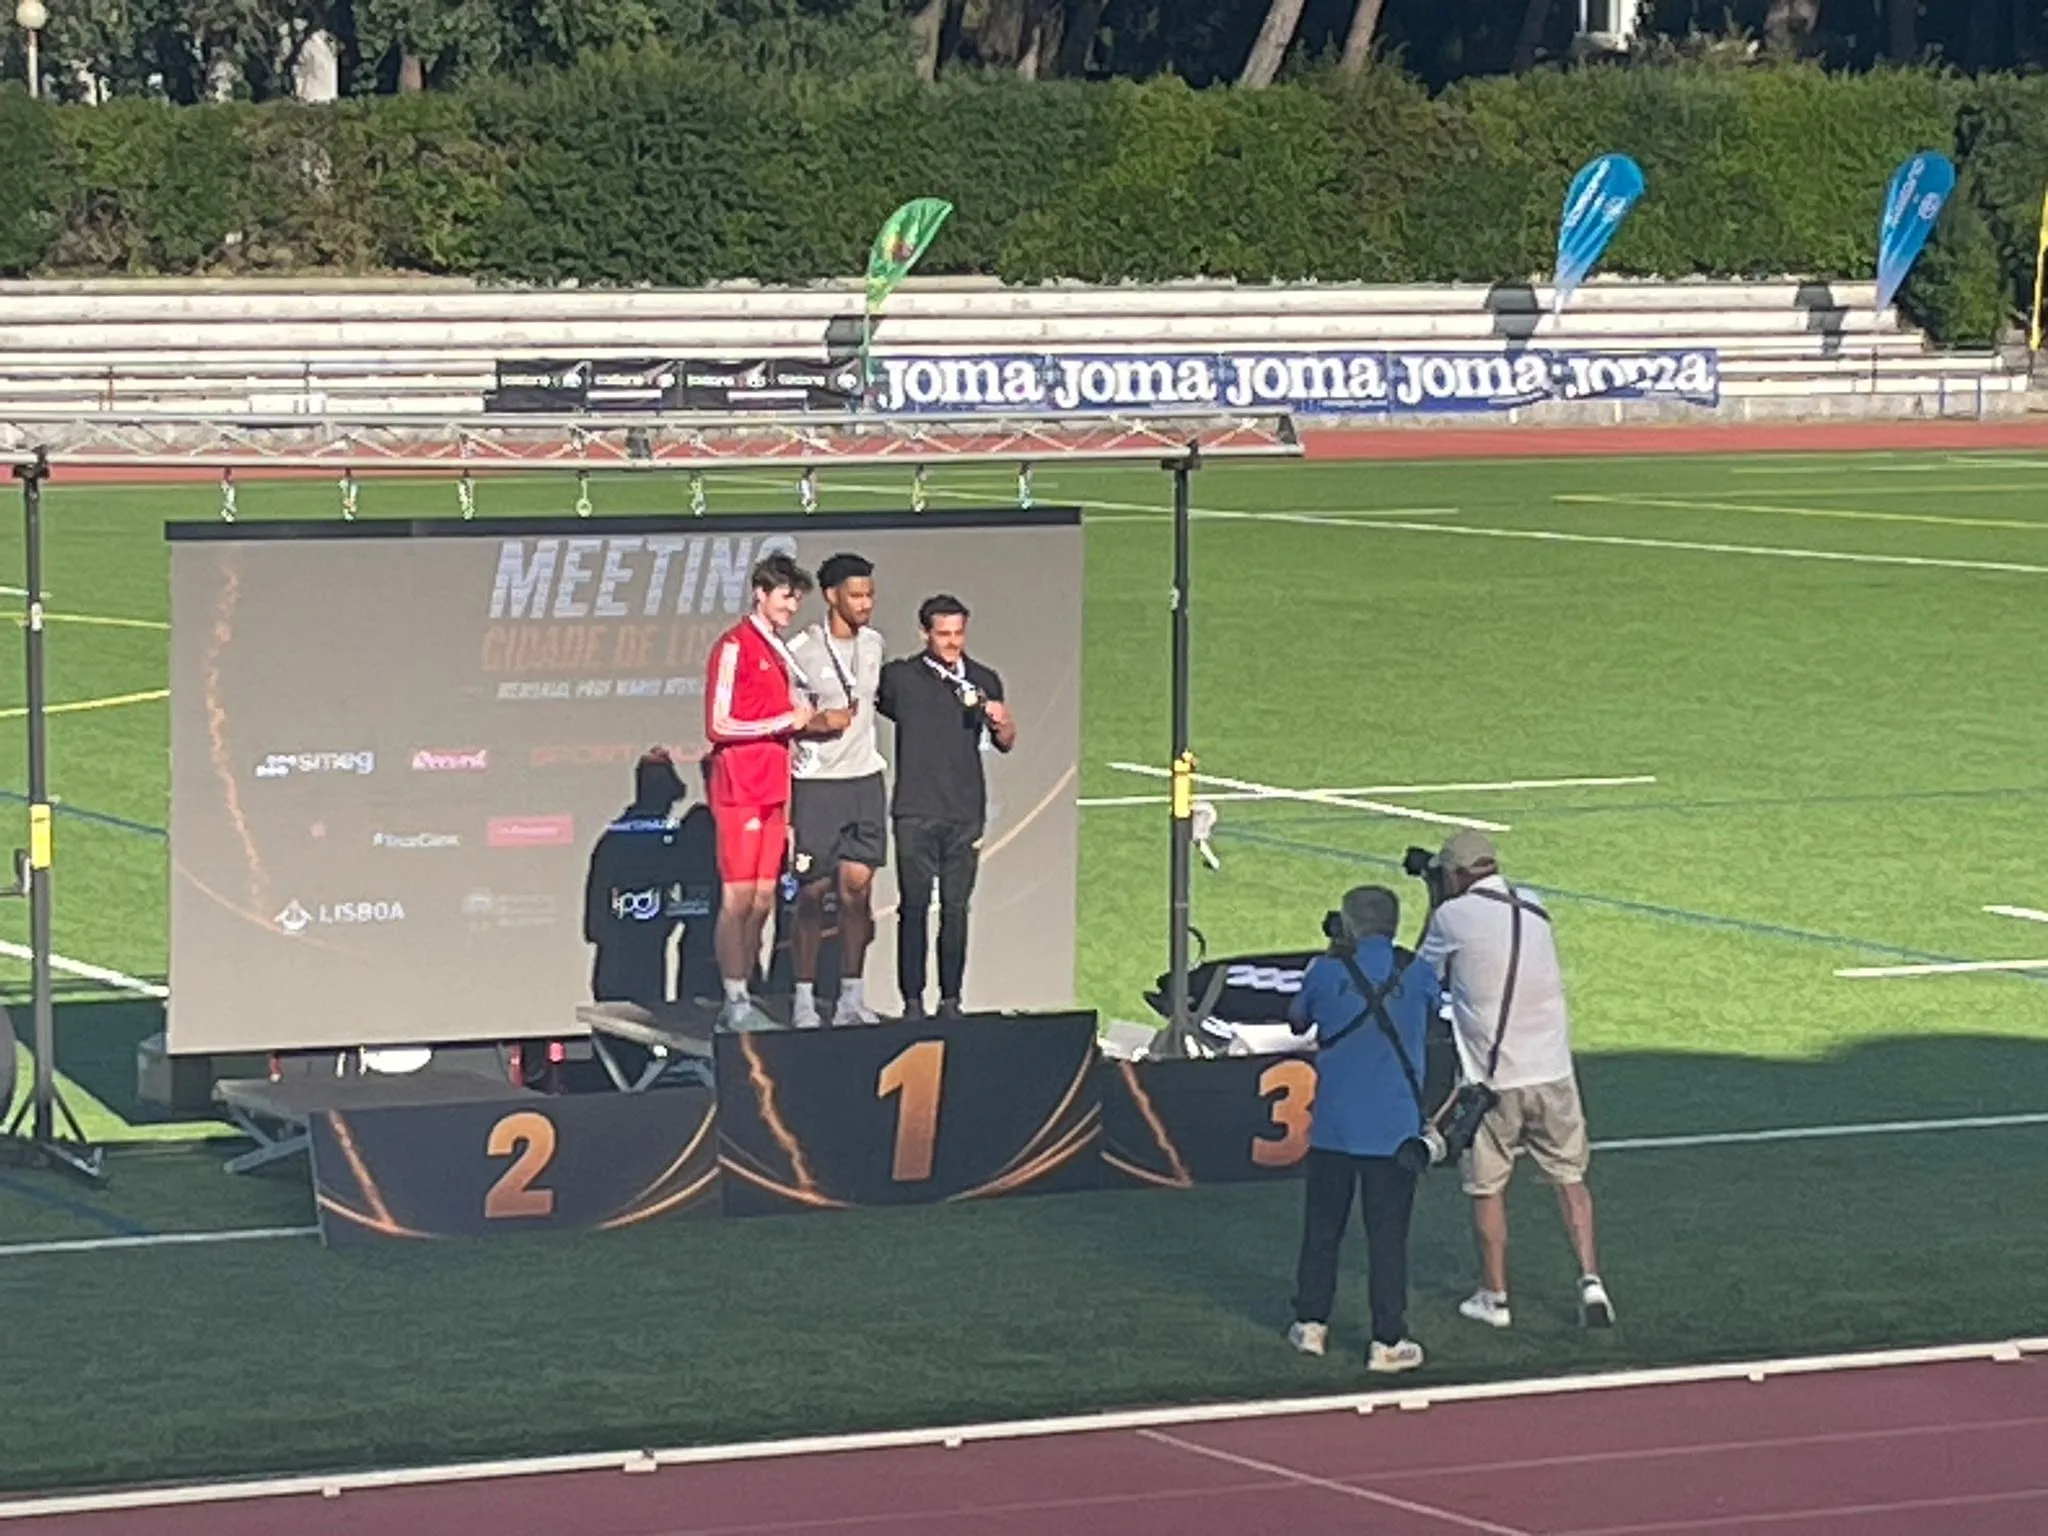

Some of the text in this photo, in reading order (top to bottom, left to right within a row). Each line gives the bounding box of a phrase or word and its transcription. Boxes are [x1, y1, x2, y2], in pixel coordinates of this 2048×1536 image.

[318, 901, 405, 923] LISBOA
[877, 1039, 945, 1181] 1
[1251, 1059, 1318, 1166] 3
[485, 1111, 557, 1219] 2
